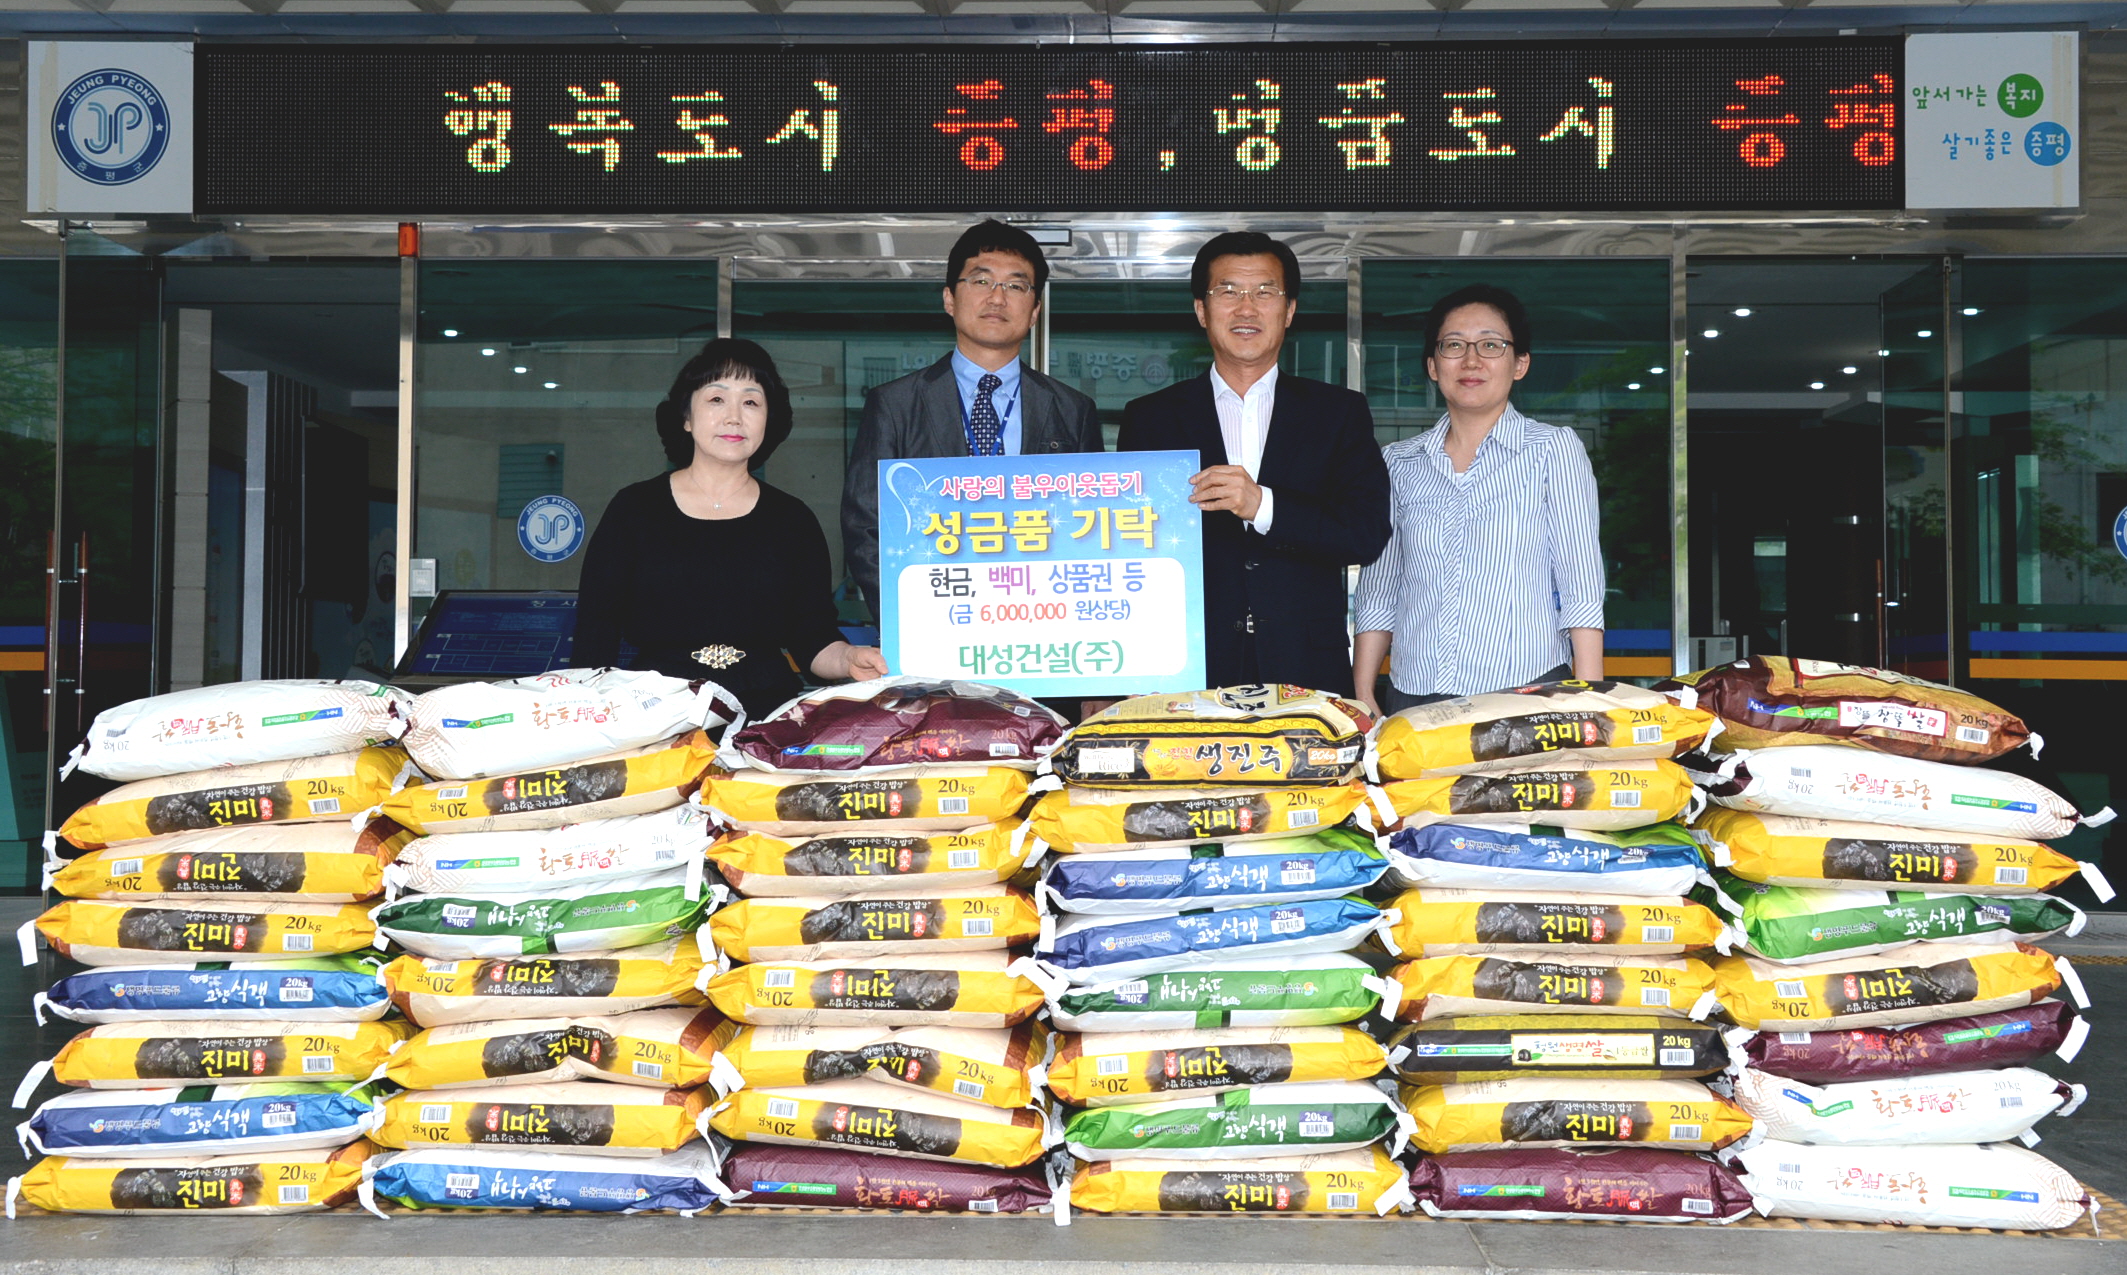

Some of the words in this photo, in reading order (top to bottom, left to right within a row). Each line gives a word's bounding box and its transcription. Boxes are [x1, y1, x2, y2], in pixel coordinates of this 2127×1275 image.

[68, 76, 103, 105] JEUNG
[112, 75, 156, 105] PYEONG
[2003, 85, 2038, 107] 복지
[1213, 77, 1614, 170] 명품도시
[1710, 74, 1894, 167] 증평
[2030, 133, 2066, 156] 증평
[940, 475, 1004, 500] 사랑의
[1012, 471, 1142, 498] 불우이웃돕기
[526, 499, 548, 515] JEUNG
[552, 498, 579, 517] PYEONG
[922, 510, 1053, 555] 성금품
[1071, 506, 1158, 550] 기탁
[929, 568, 976, 598] 현금,
[989, 565, 1036, 595] 백미,
[1049, 562, 1111, 594] 상품권
[1122, 562, 1146, 592] 등
[949, 605, 973, 625] (금
[980, 603, 1067, 624] 6,000,000
[1075, 599, 1131, 621] 원상당)
[959, 640, 1124, 674] 대성건설(주)
[1535, 723, 1581, 751] 진미
[1196, 743, 1282, 776] 생진주
[518, 771, 568, 797] 진미
[1512, 783, 1559, 811] 진미
[209, 798, 257, 826] 진미
[839, 792, 885, 820] 진미
[1188, 809, 1236, 837] 진미
[193, 853, 242, 880] 진미
[848, 847, 896, 874] 진미
[1286, 861, 1309, 870] 20kg
[1889, 854, 1939, 881] 진미
[862, 912, 909, 940] 진미
[1275, 910, 1299, 920] 20kg
[183, 923, 231, 951] 진미
[1541, 915, 1589, 943] 진미
[285, 978, 308, 988] 20kg
[507, 960, 555, 984] 진미
[848, 970, 895, 997] 진미
[1860, 969, 1912, 998] 진미
[1539, 975, 1586, 1003] 진미
[201, 1050, 249, 1077] 진미
[1180, 1047, 1228, 1076] 진미
[268, 1104, 291, 1113] 20kg
[503, 1105, 550, 1132] 진미
[1304, 1112, 1328, 1123] 20kg
[849, 1109, 898, 1137] 진미
[1566, 1114, 1615, 1141] 진미
[177, 1180, 226, 1207] 진미
[1224, 1184, 1273, 1211] 진미
